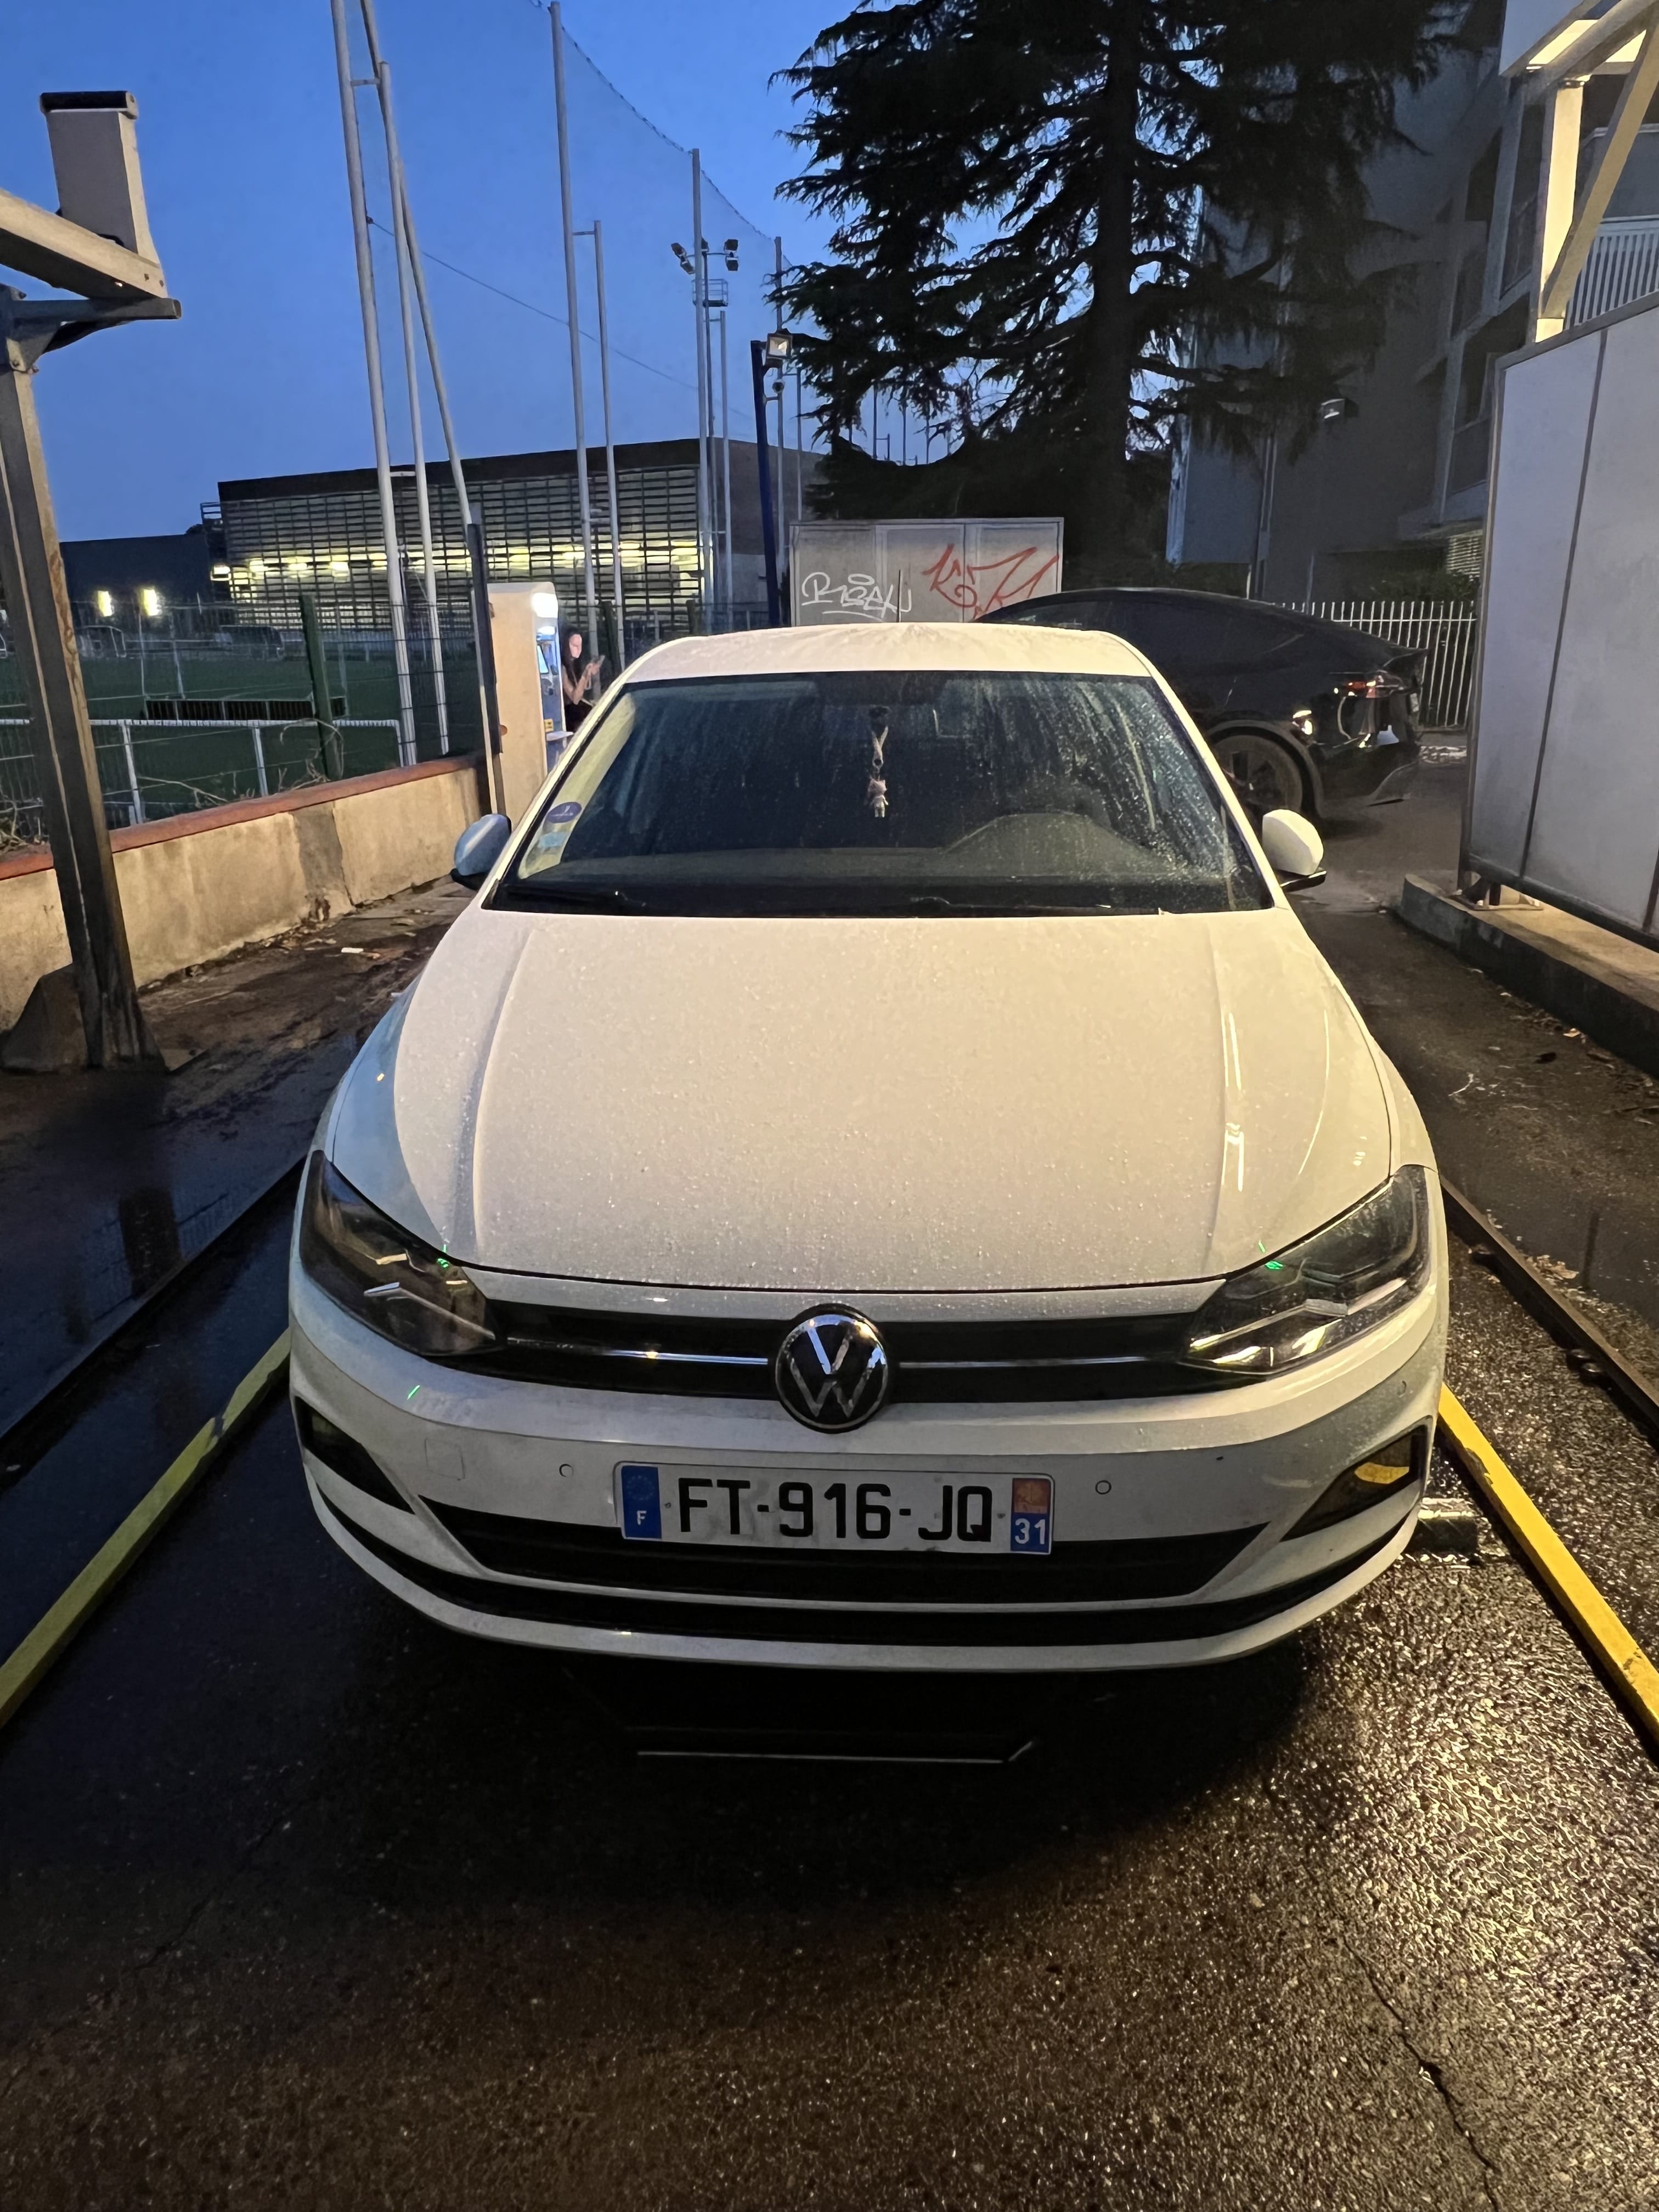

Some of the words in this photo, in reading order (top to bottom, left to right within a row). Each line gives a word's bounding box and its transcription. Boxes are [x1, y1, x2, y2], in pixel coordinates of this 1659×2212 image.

[783, 1321, 887, 1420] VW
[637, 1510, 647, 1525] F
[679, 1477, 992, 1542] FT-916-JQ
[1014, 1518, 1046, 1545] 31
